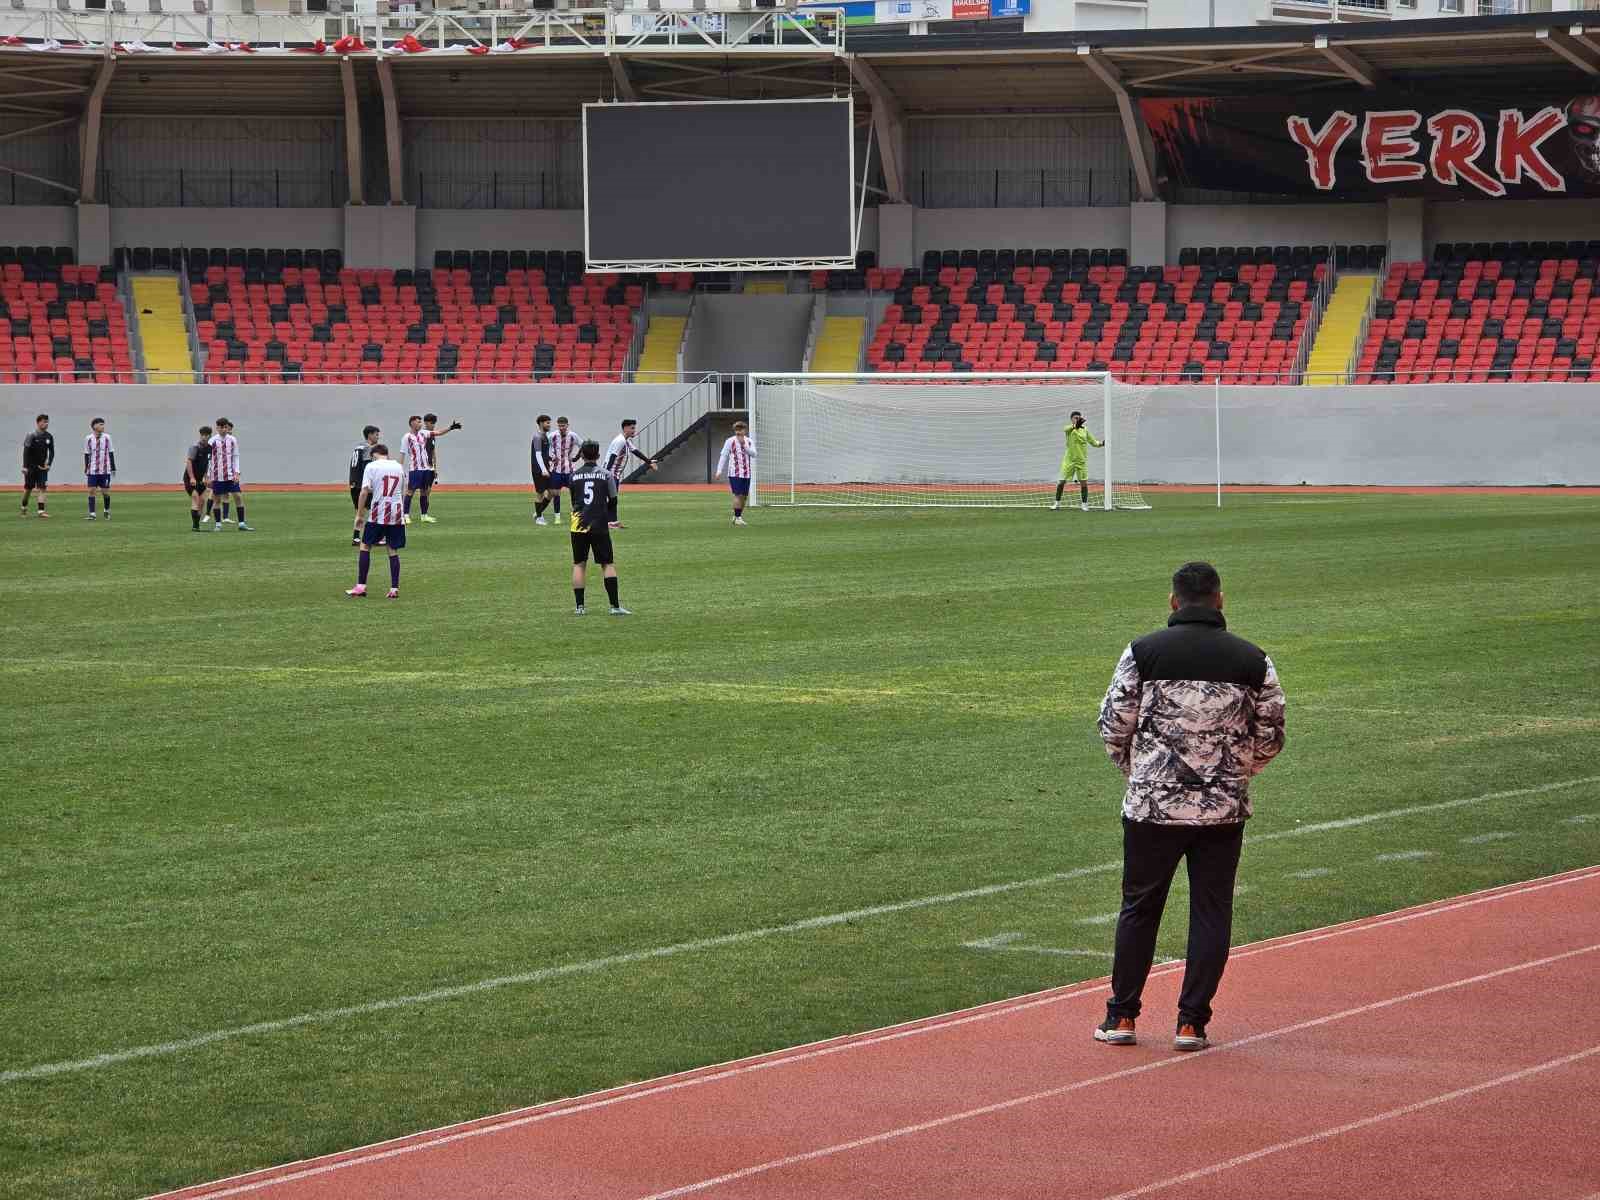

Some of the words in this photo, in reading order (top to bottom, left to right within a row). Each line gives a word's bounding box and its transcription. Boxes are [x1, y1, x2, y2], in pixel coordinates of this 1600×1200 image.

[1287, 108, 1568, 198] YERK
[382, 475, 399, 497] 17
[583, 481, 595, 505] 5
